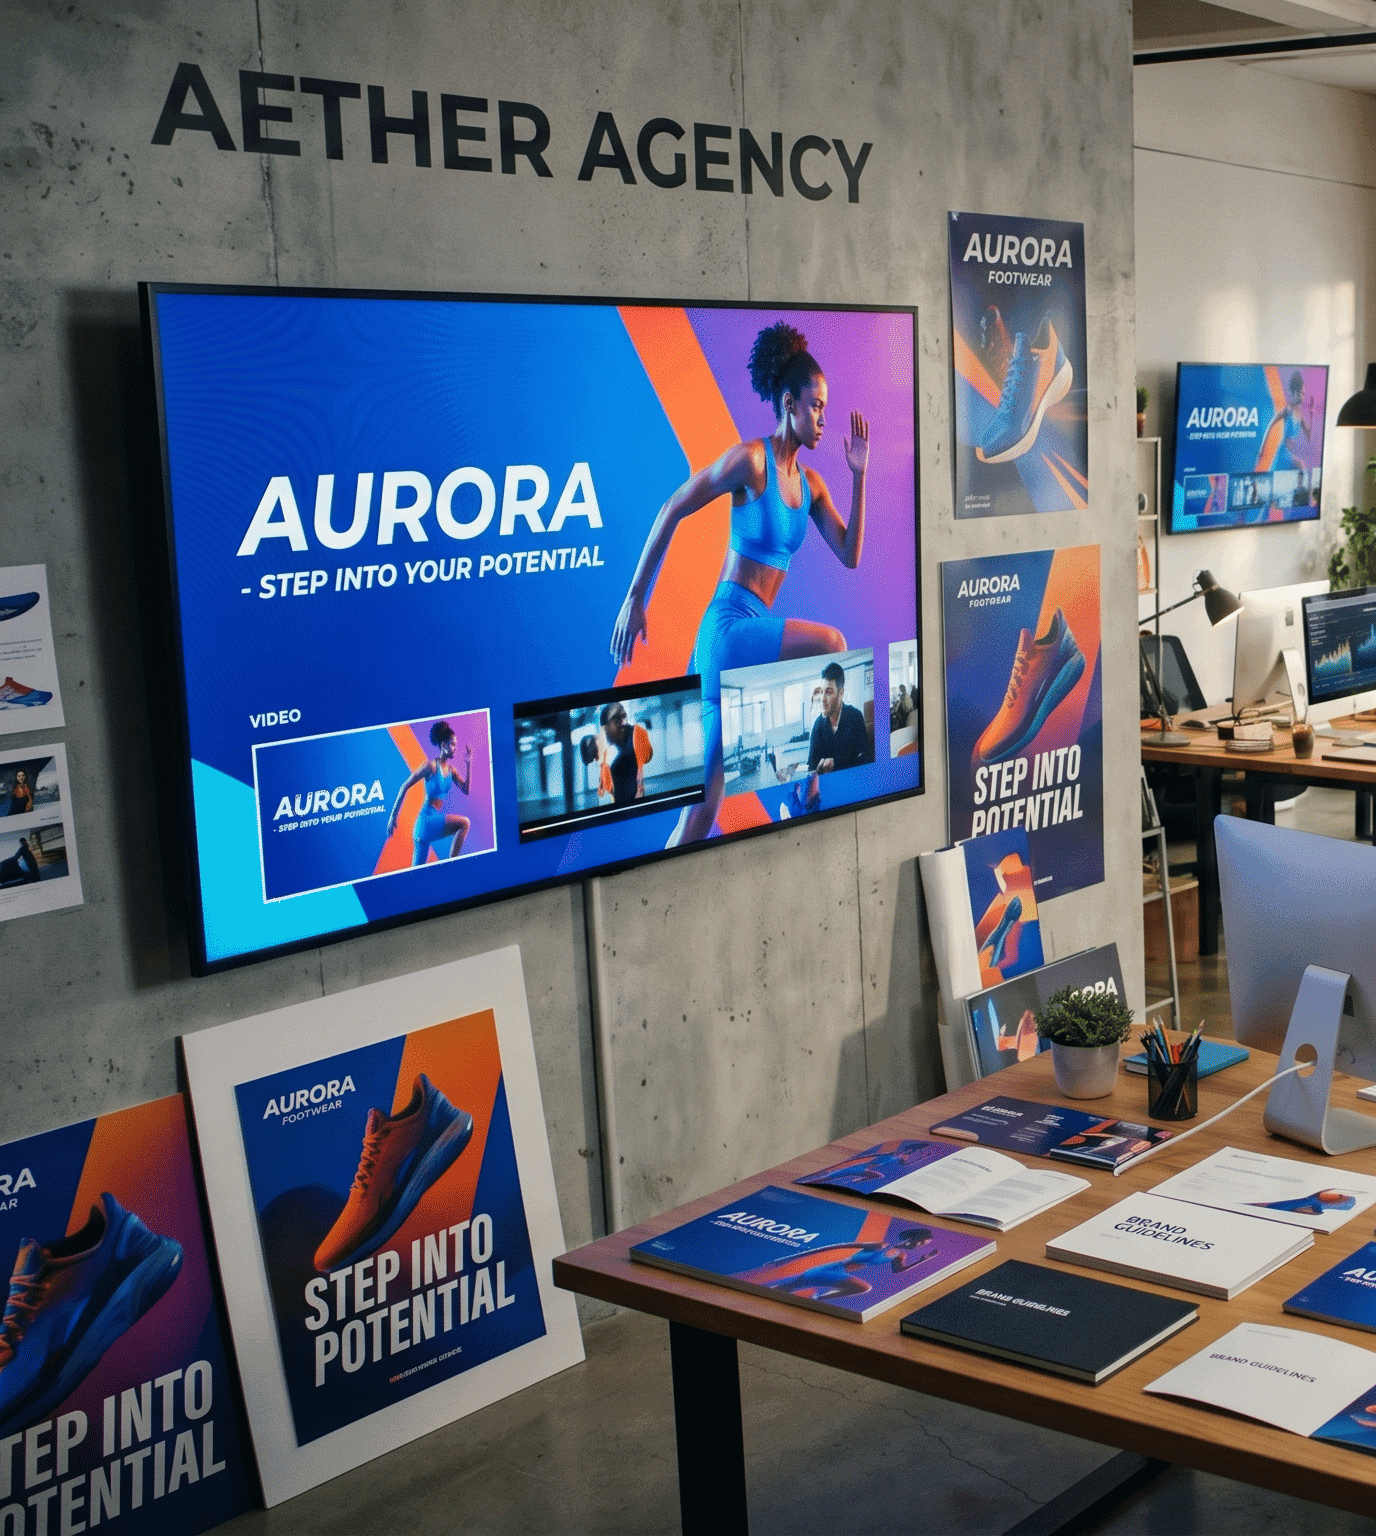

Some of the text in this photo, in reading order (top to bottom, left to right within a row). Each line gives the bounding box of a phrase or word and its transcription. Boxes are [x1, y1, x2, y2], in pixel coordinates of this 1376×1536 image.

[151, 62, 873, 204] AETHER AGENCY
[962, 232, 1073, 268] AURORA
[988, 270, 1052, 286] FOOTWEAR
[1186, 407, 1259, 428] AURORA
[237, 462, 604, 557] AURORA
[259, 570, 329, 600] STEP
[335, 563, 398, 592] INTO
[403, 556, 473, 586] YOUR
[478, 545, 605, 580] POTENTIAL
[957, 574, 1020, 599] AURORA
[249, 708, 302, 728] VIDEO
[974, 744, 1081, 805] STEP INTO
[273, 779, 385, 821] AURORA
[972, 784, 1083, 839] POTENTIAL
[262, 1075, 356, 1120] AURORA
[282, 1100, 342, 1126] FOOTWEAR
[717, 1212, 820, 1243] AURORA
[1114, 1222, 1215, 1250] GUIDELINES
[1125, 1216, 1187, 1234] BRAND
[304, 1213, 493, 1331] STEP INTO
[315, 1261, 515, 1388] POTENTIAL
[0, 1360, 213, 1500] TEP INTO
[0, 1420, 226, 1536] OTENTIAL
